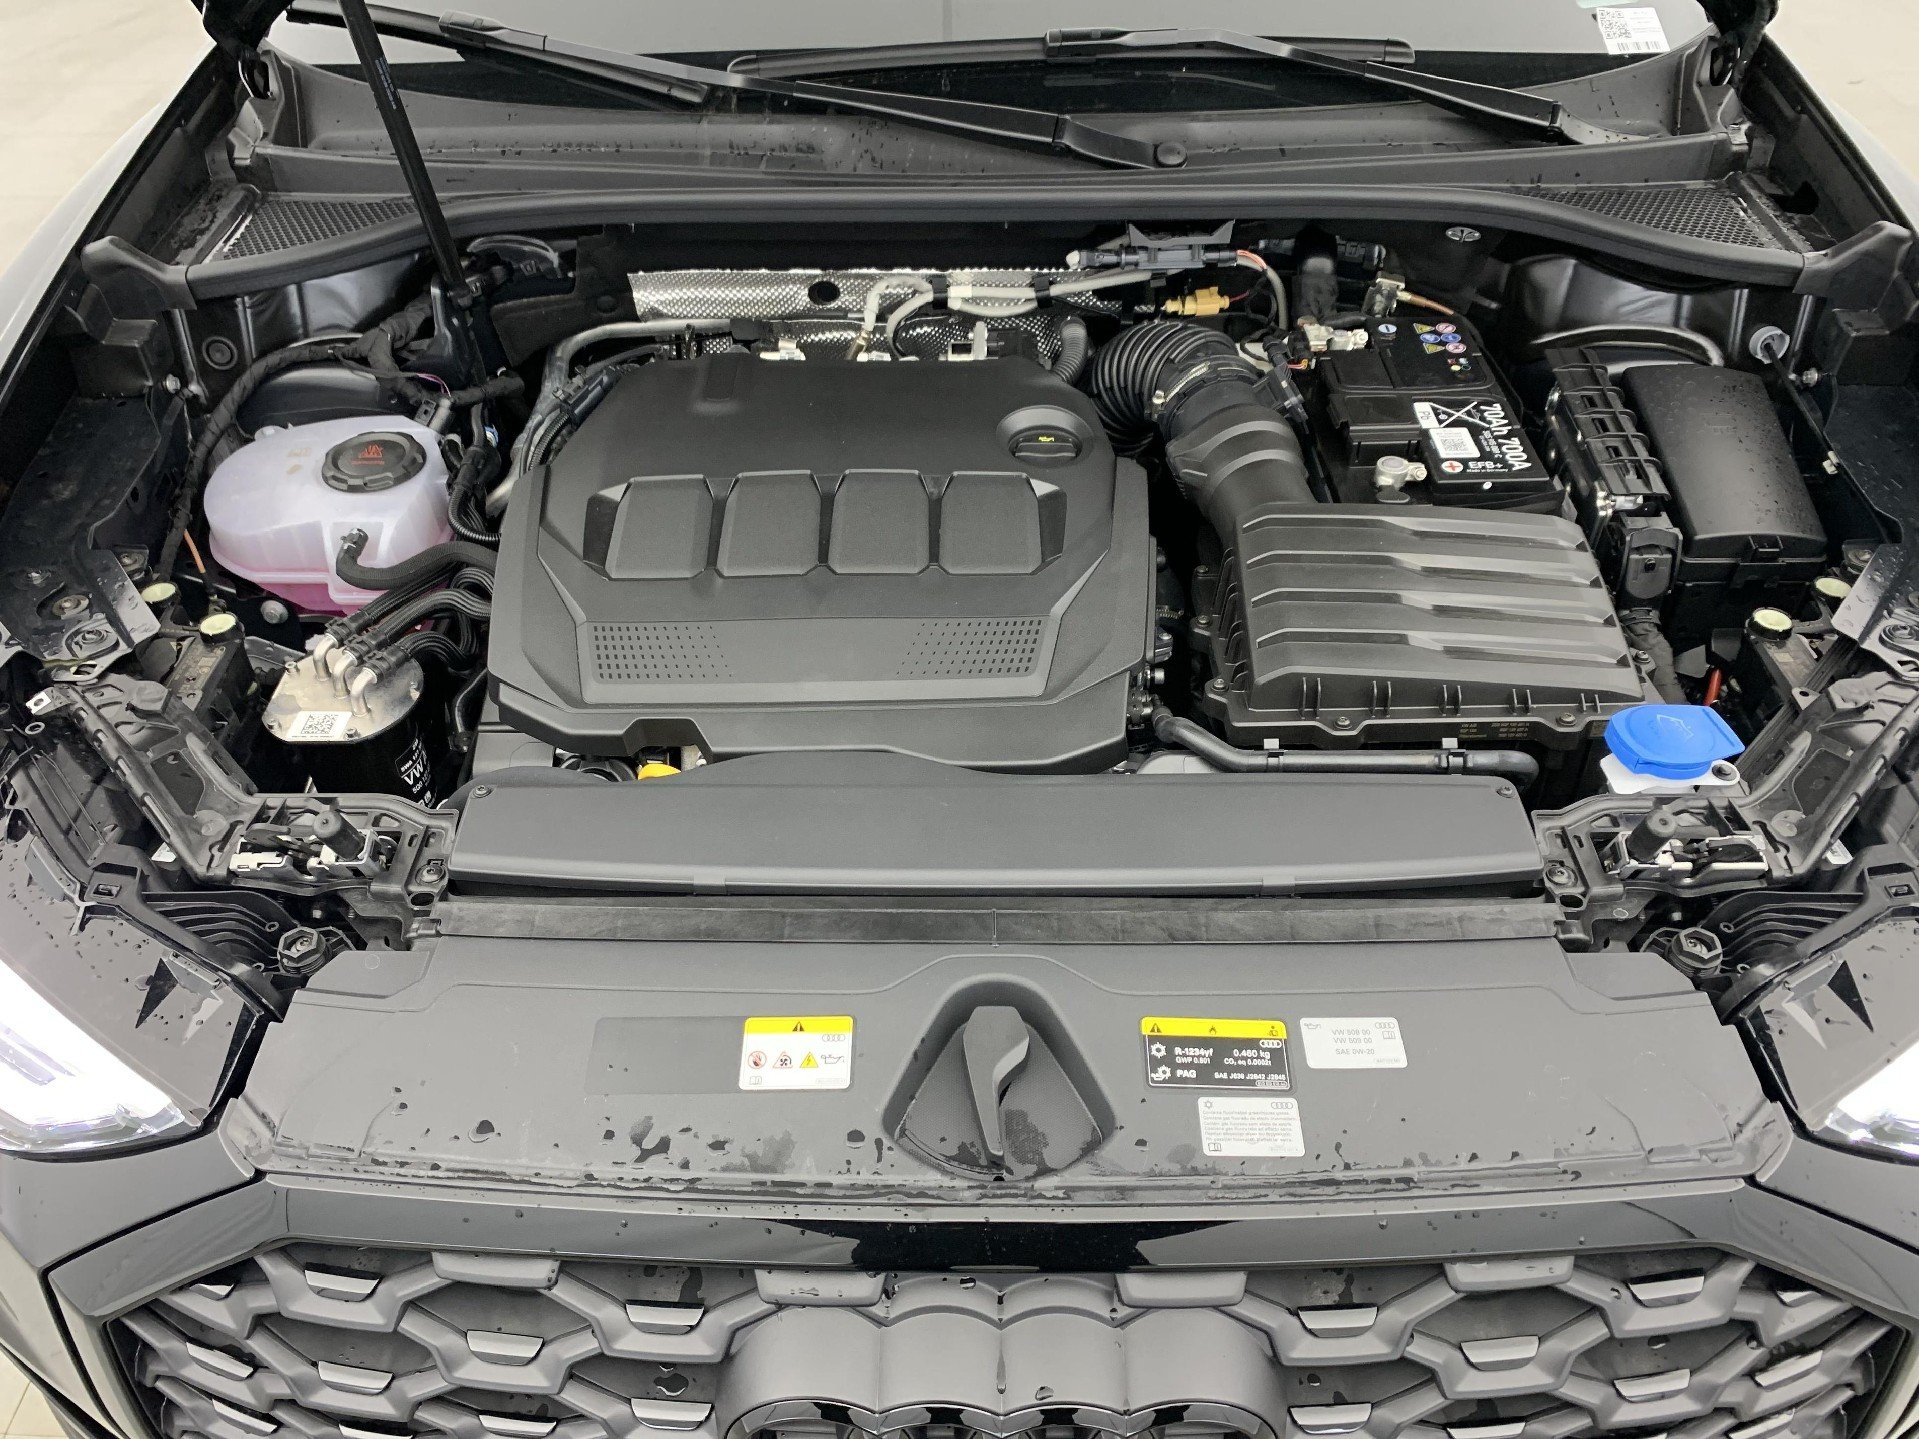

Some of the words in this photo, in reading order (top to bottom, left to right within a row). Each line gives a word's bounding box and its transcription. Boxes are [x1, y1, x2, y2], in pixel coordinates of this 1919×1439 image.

[1480, 403, 1512, 436] 70Ah
[1498, 437, 1532, 471] 700A
[1468, 461, 1503, 469] EFB+
[404, 758, 423, 785] VW
[1174, 1046, 1213, 1057] R-1234yf
[1259, 1049, 1271, 1060] kg
[1176, 1069, 1197, 1078] PAG
